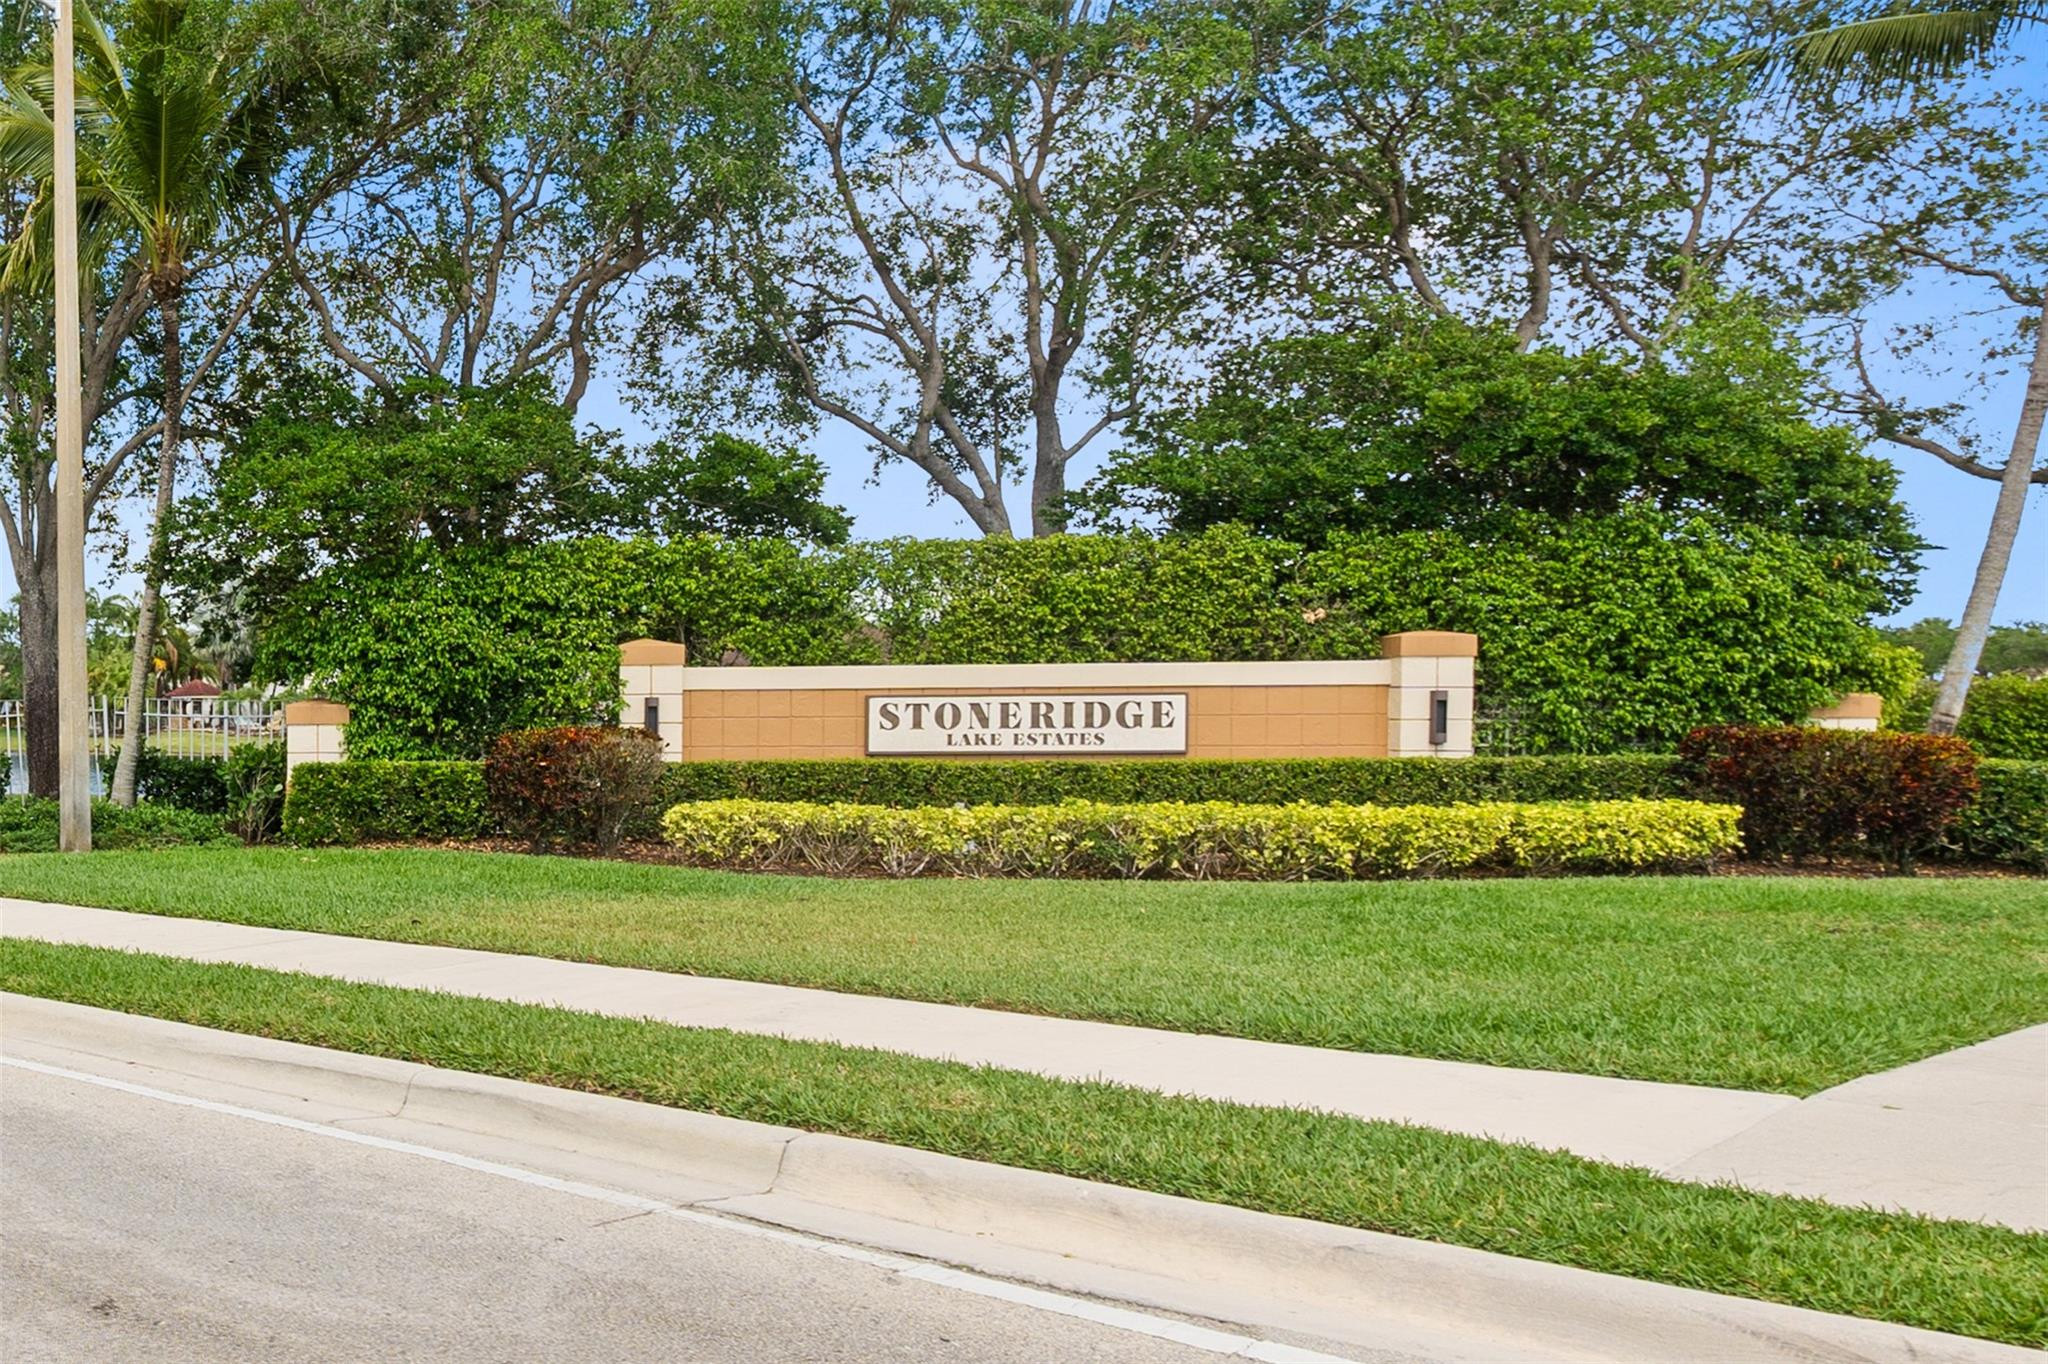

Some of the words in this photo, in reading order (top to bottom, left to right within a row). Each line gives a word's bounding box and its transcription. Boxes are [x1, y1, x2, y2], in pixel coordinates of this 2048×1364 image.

[879, 701, 1175, 730] STONERIDGE
[947, 733, 1002, 746] LAKE
[1013, 732, 1105, 746] ESTATES
